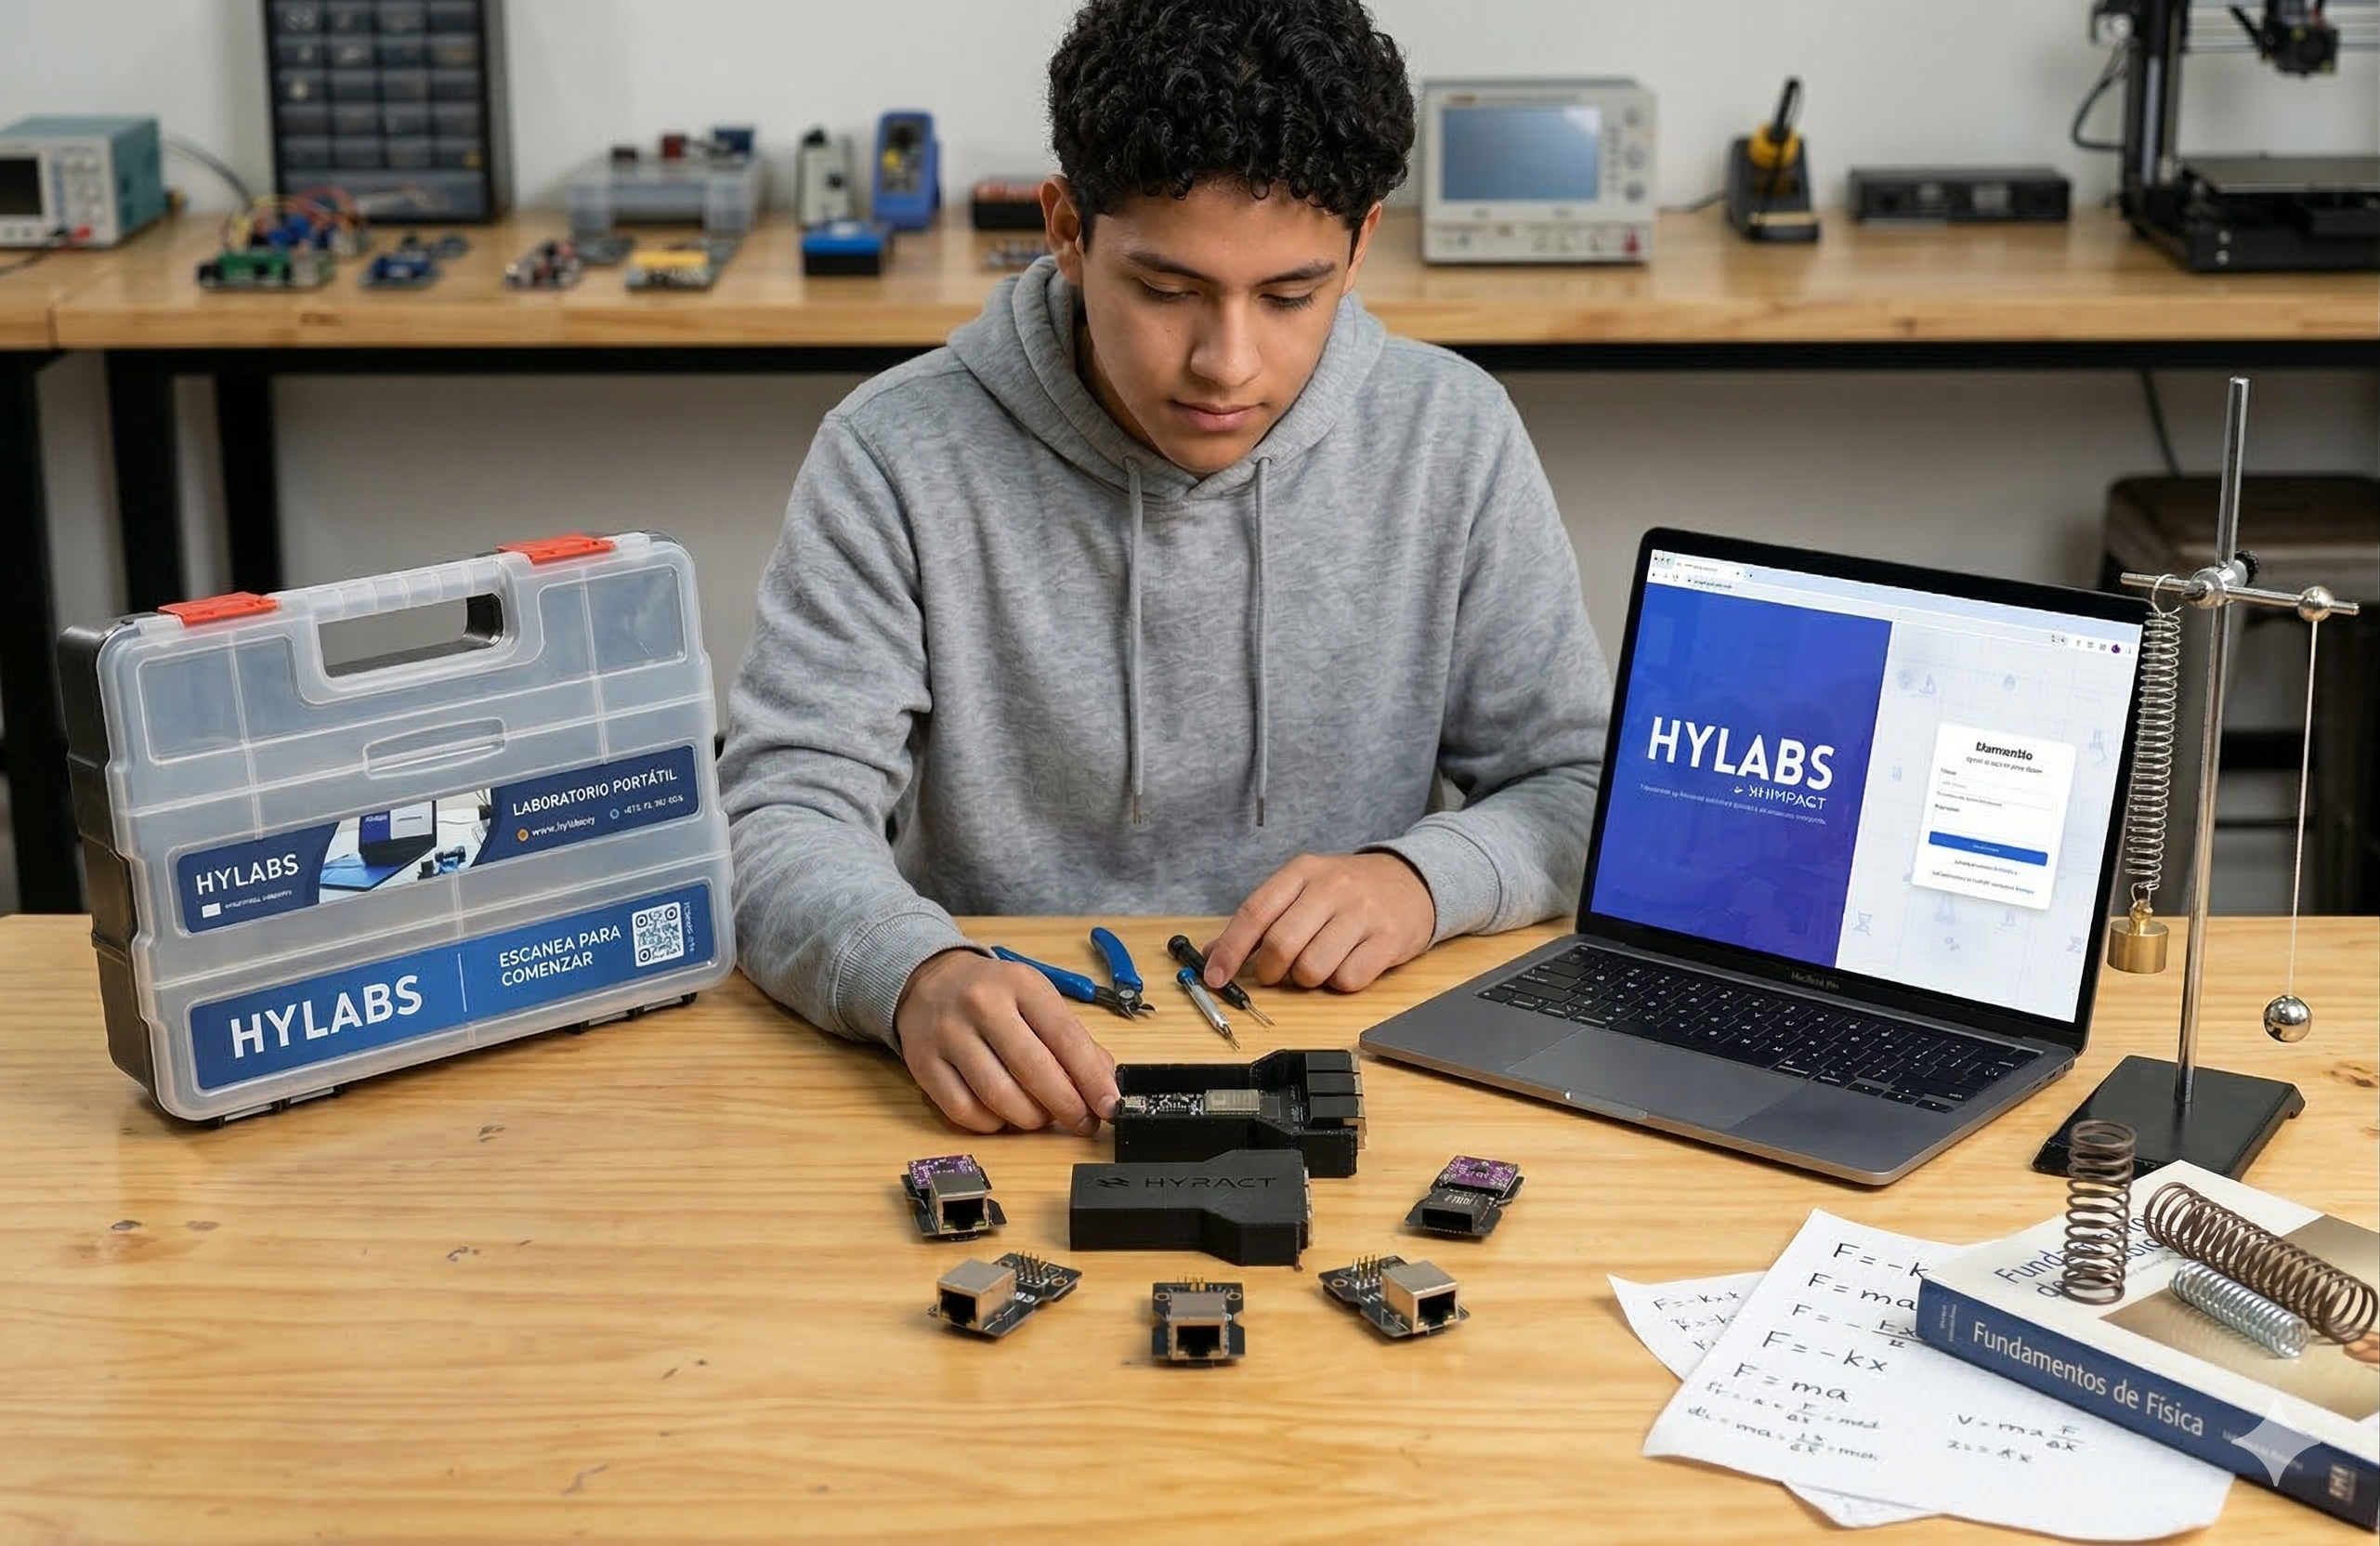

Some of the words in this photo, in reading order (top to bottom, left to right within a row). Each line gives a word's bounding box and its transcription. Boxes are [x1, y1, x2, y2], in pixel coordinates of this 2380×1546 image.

[1647, 715, 1835, 791] HYLABS
[513, 782, 608, 817] LABORATORIO
[613, 768, 677, 793] PORTÁTIL
[196, 853, 299, 896] HYLABS
[499, 937, 575, 968] ESCANEA
[579, 924, 621, 949] PARA
[502, 950, 593, 988] COMENZAR
[230, 975, 423, 1059] HYLABS
[1145, 1176, 1277, 1189] HYRACT
[1973, 1321, 2106, 1395] Fundamentos
[2113, 1379, 2138, 1409] de
[2146, 1392, 2204, 1436] Física
